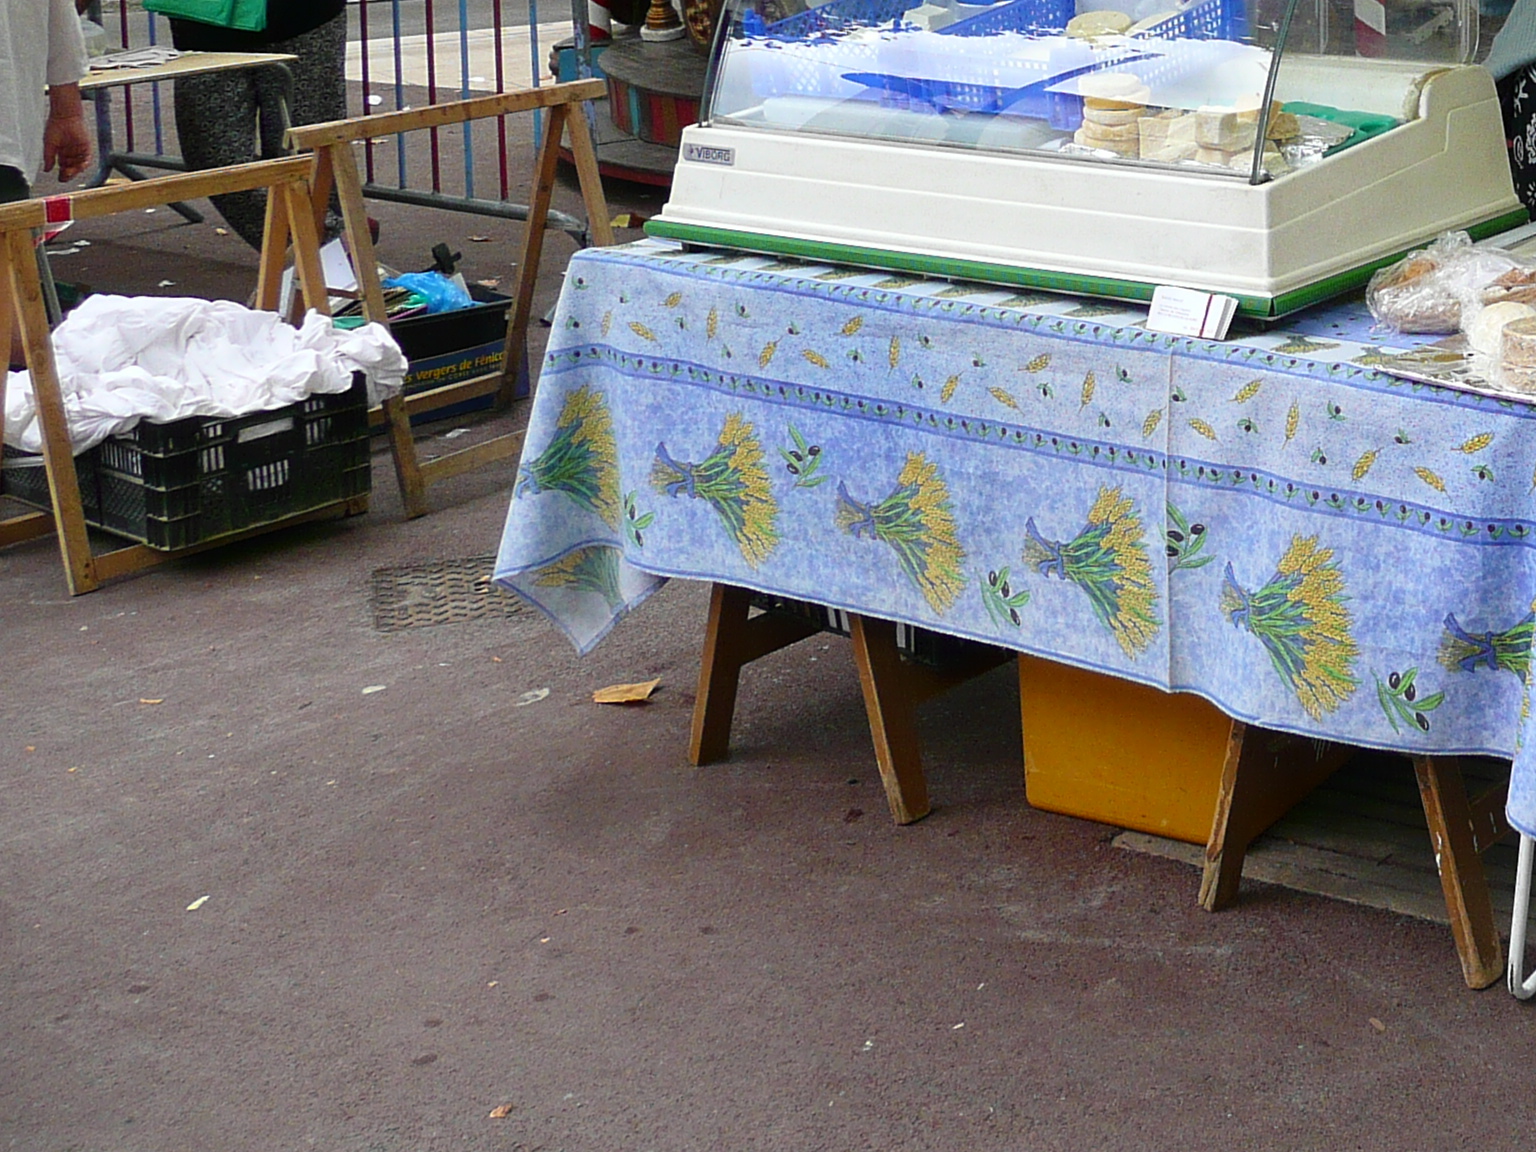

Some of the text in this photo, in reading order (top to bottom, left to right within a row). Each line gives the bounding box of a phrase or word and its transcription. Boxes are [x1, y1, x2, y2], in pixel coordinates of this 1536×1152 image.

[694, 146, 731, 162] VIBORG
[416, 363, 457, 381] Vergers
[459, 358, 473, 370] de
